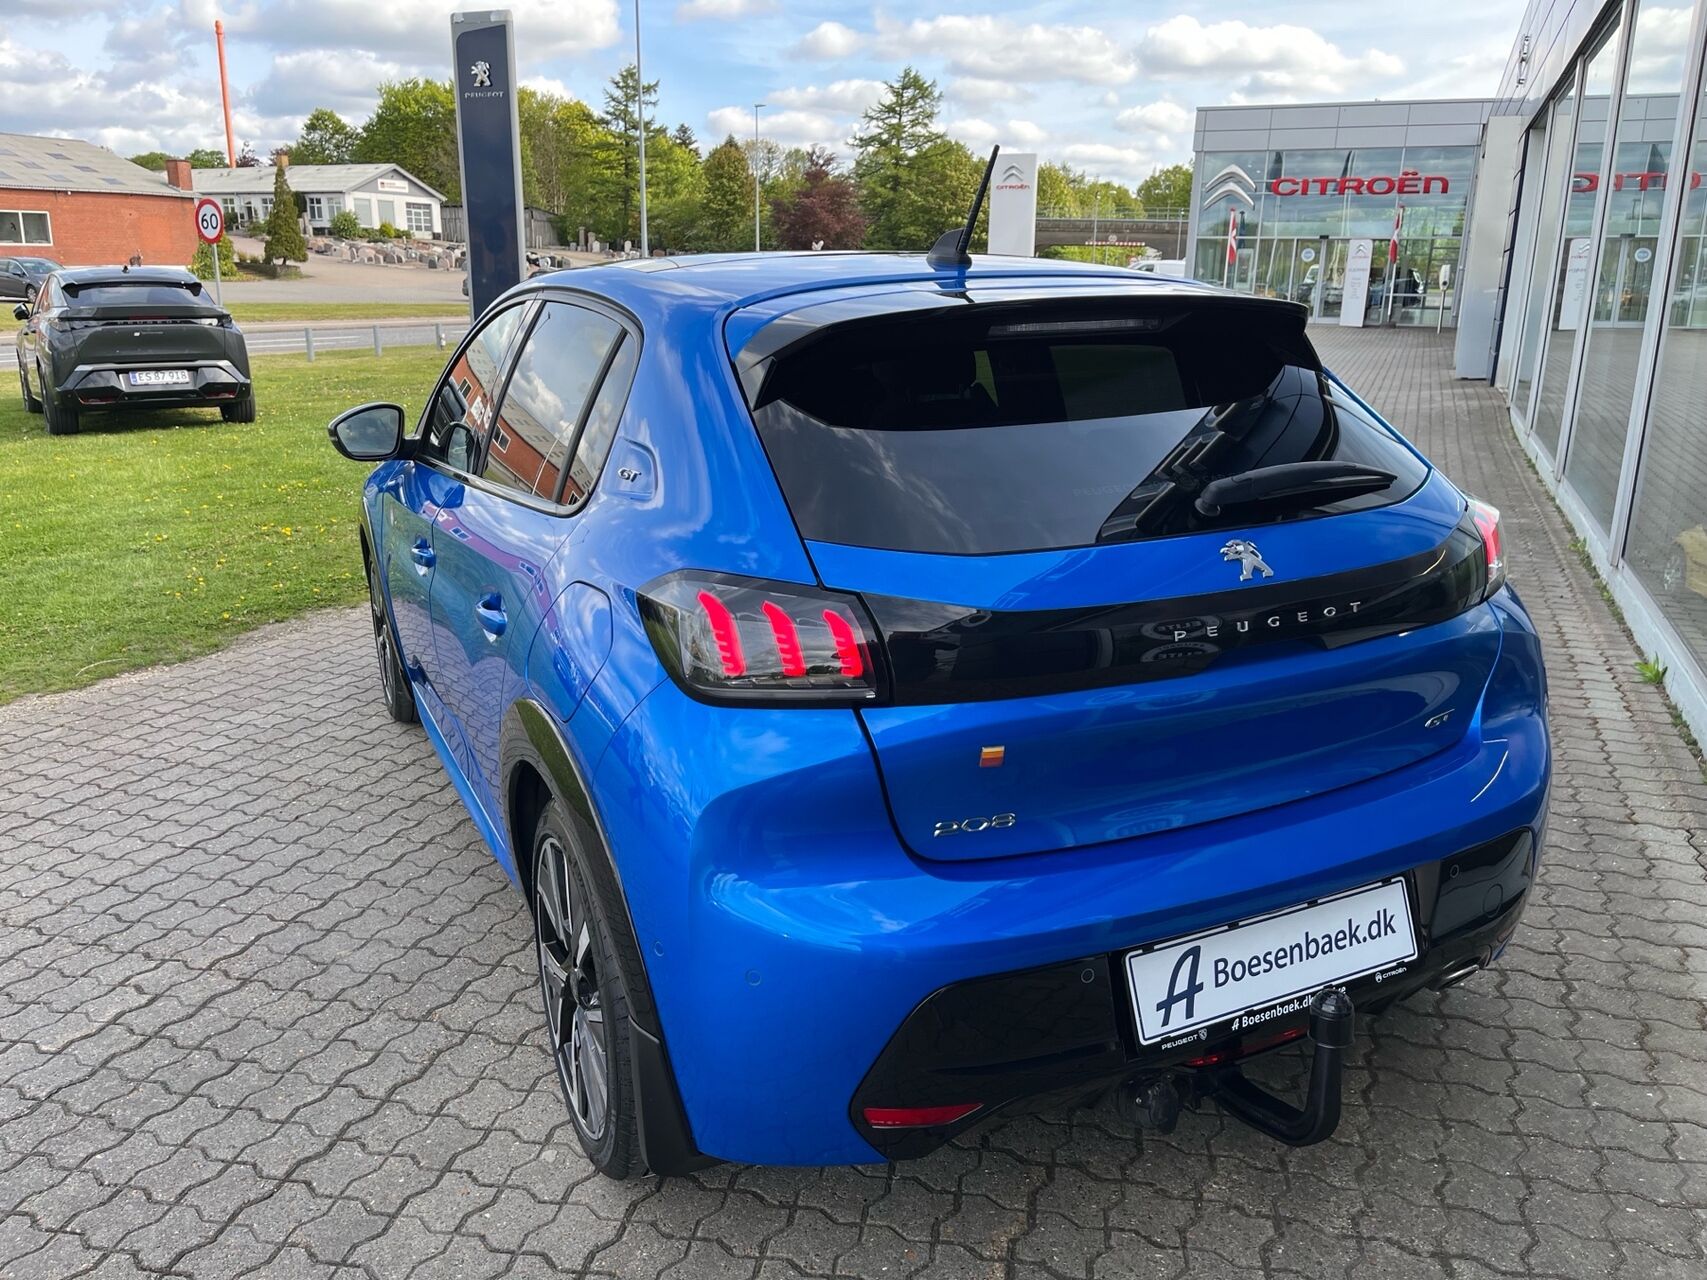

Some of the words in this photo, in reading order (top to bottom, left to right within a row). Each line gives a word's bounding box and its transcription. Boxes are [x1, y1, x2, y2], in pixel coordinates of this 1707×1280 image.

[464, 91, 504, 99] PEUGEOT
[201, 213, 219, 230] 60
[138, 372, 152, 382] ES
[617, 467, 642, 483] GT
[1173, 601, 1361, 643] PEUGEOT
[1424, 708, 1456, 728] GT
[933, 812, 1016, 838] 208
[1214, 908, 1397, 988] Boesenbaek.dk
[1161, 1034, 1199, 1051] PEUGEOT
